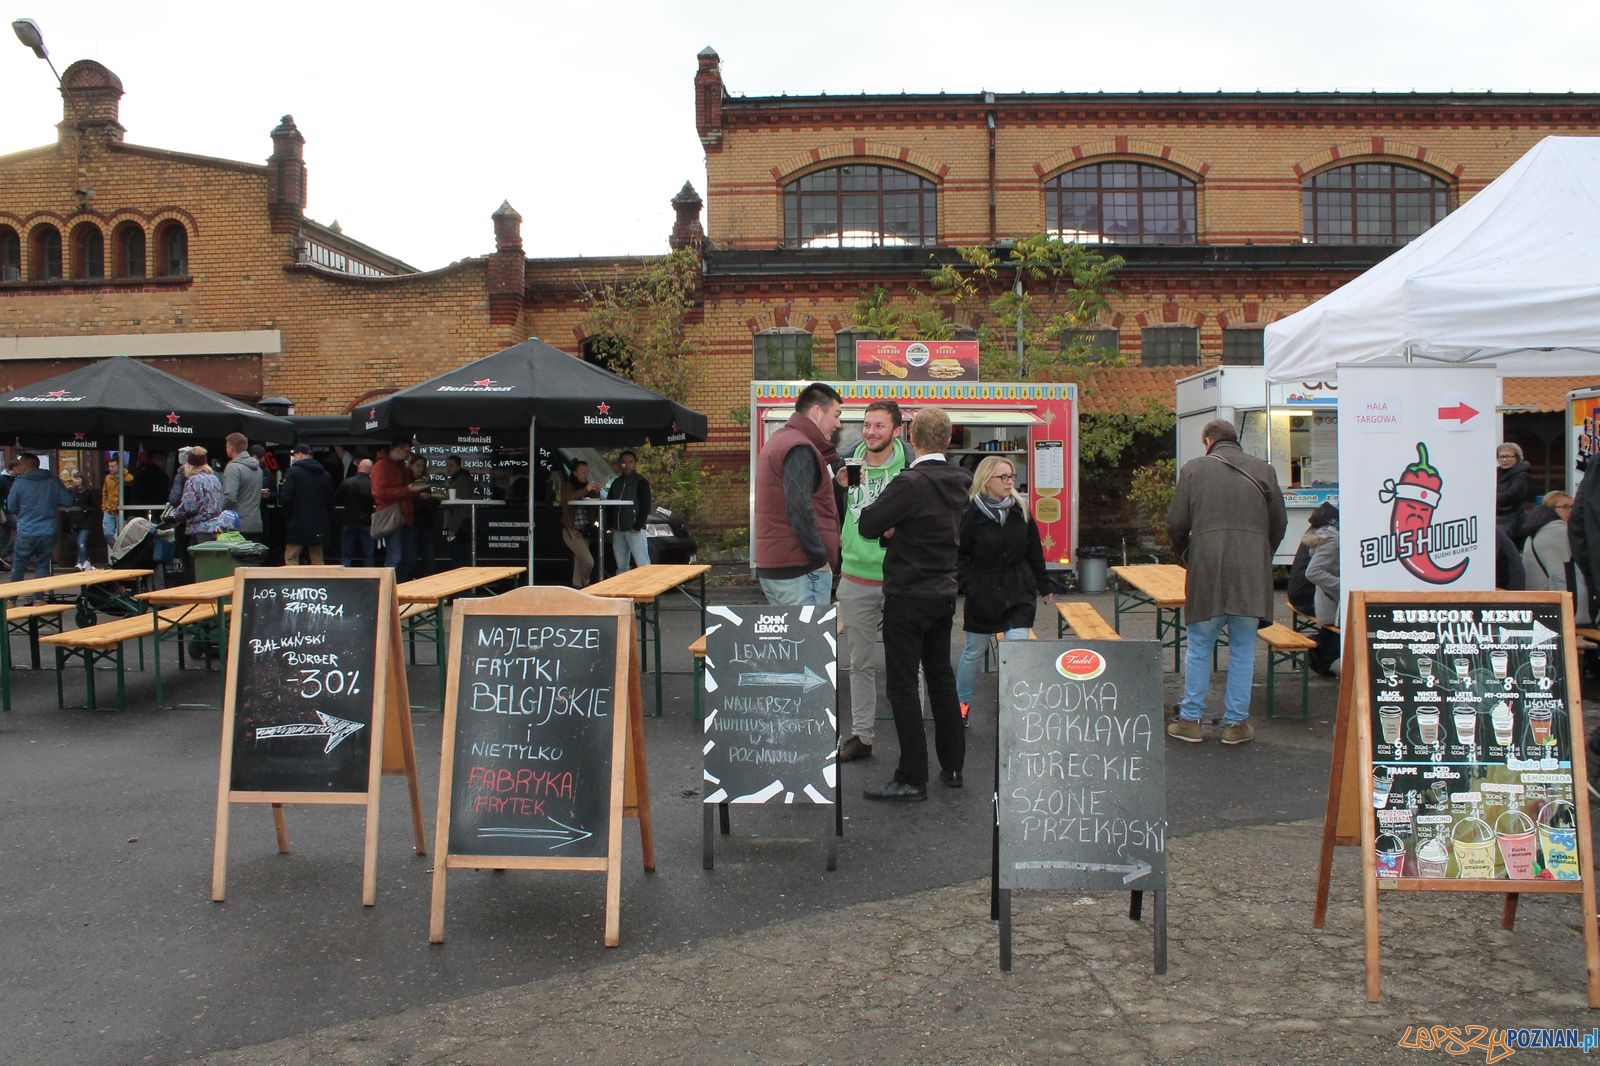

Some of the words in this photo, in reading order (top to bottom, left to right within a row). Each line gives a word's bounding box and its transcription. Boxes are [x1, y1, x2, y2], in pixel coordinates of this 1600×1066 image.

[1366, 402, 1388, 410] HALA
[584, 416, 624, 424] Heineken
[1356, 415, 1397, 424] TARGOWA
[152, 424, 193, 434] Heineken
[429, 446, 444, 454] FOG
[1360, 516, 1478, 568] BUSHIMI
[1434, 552, 1452, 560] SUSHI
[1452, 544, 1478, 556] BURRITO
[252, 588, 277, 600] LOS
[282, 588, 328, 600] SANTOS
[284, 602, 344, 616] ZAPRASZA
[1392, 610, 1474, 623] RUBICON
[1481, 610, 1533, 624] MENU
[754, 623, 786, 633] LEMON
[478, 626, 600, 656] NAJLEPSZE
[730, 638, 804, 662] LEWANT
[282, 651, 339, 668] BURGER
[475, 657, 560, 682] FRYTKI
[286, 669, 360, 698] -30%
[1388, 674, 1398, 687] 5
[1426, 674, 1435, 688] 8
[1504, 676, 1514, 690] 8
[1538, 676, 1550, 690] 10
[1012, 680, 1118, 712] SŁODKA
[470, 682, 610, 725] BELGIJSKIE
[724, 696, 802, 714] NAJLEPSZY
[526, 723, 532, 742] i
[778, 718, 824, 735] KOFTY
[1018, 712, 1152, 752] BAKLAVA
[1394, 738, 1403, 748] 6
[1394, 748, 1402, 760] 9
[1430, 752, 1442, 762] 10
[1019, 750, 1142, 781] TURECKIE
[468, 768, 574, 799] FABRYKA
[1522, 774, 1572, 782] LEMONIADA
[1012, 786, 1106, 816] SŁONE
[1452, 794, 1480, 802] SHAKE
[475, 796, 545, 816] FRYTEK
